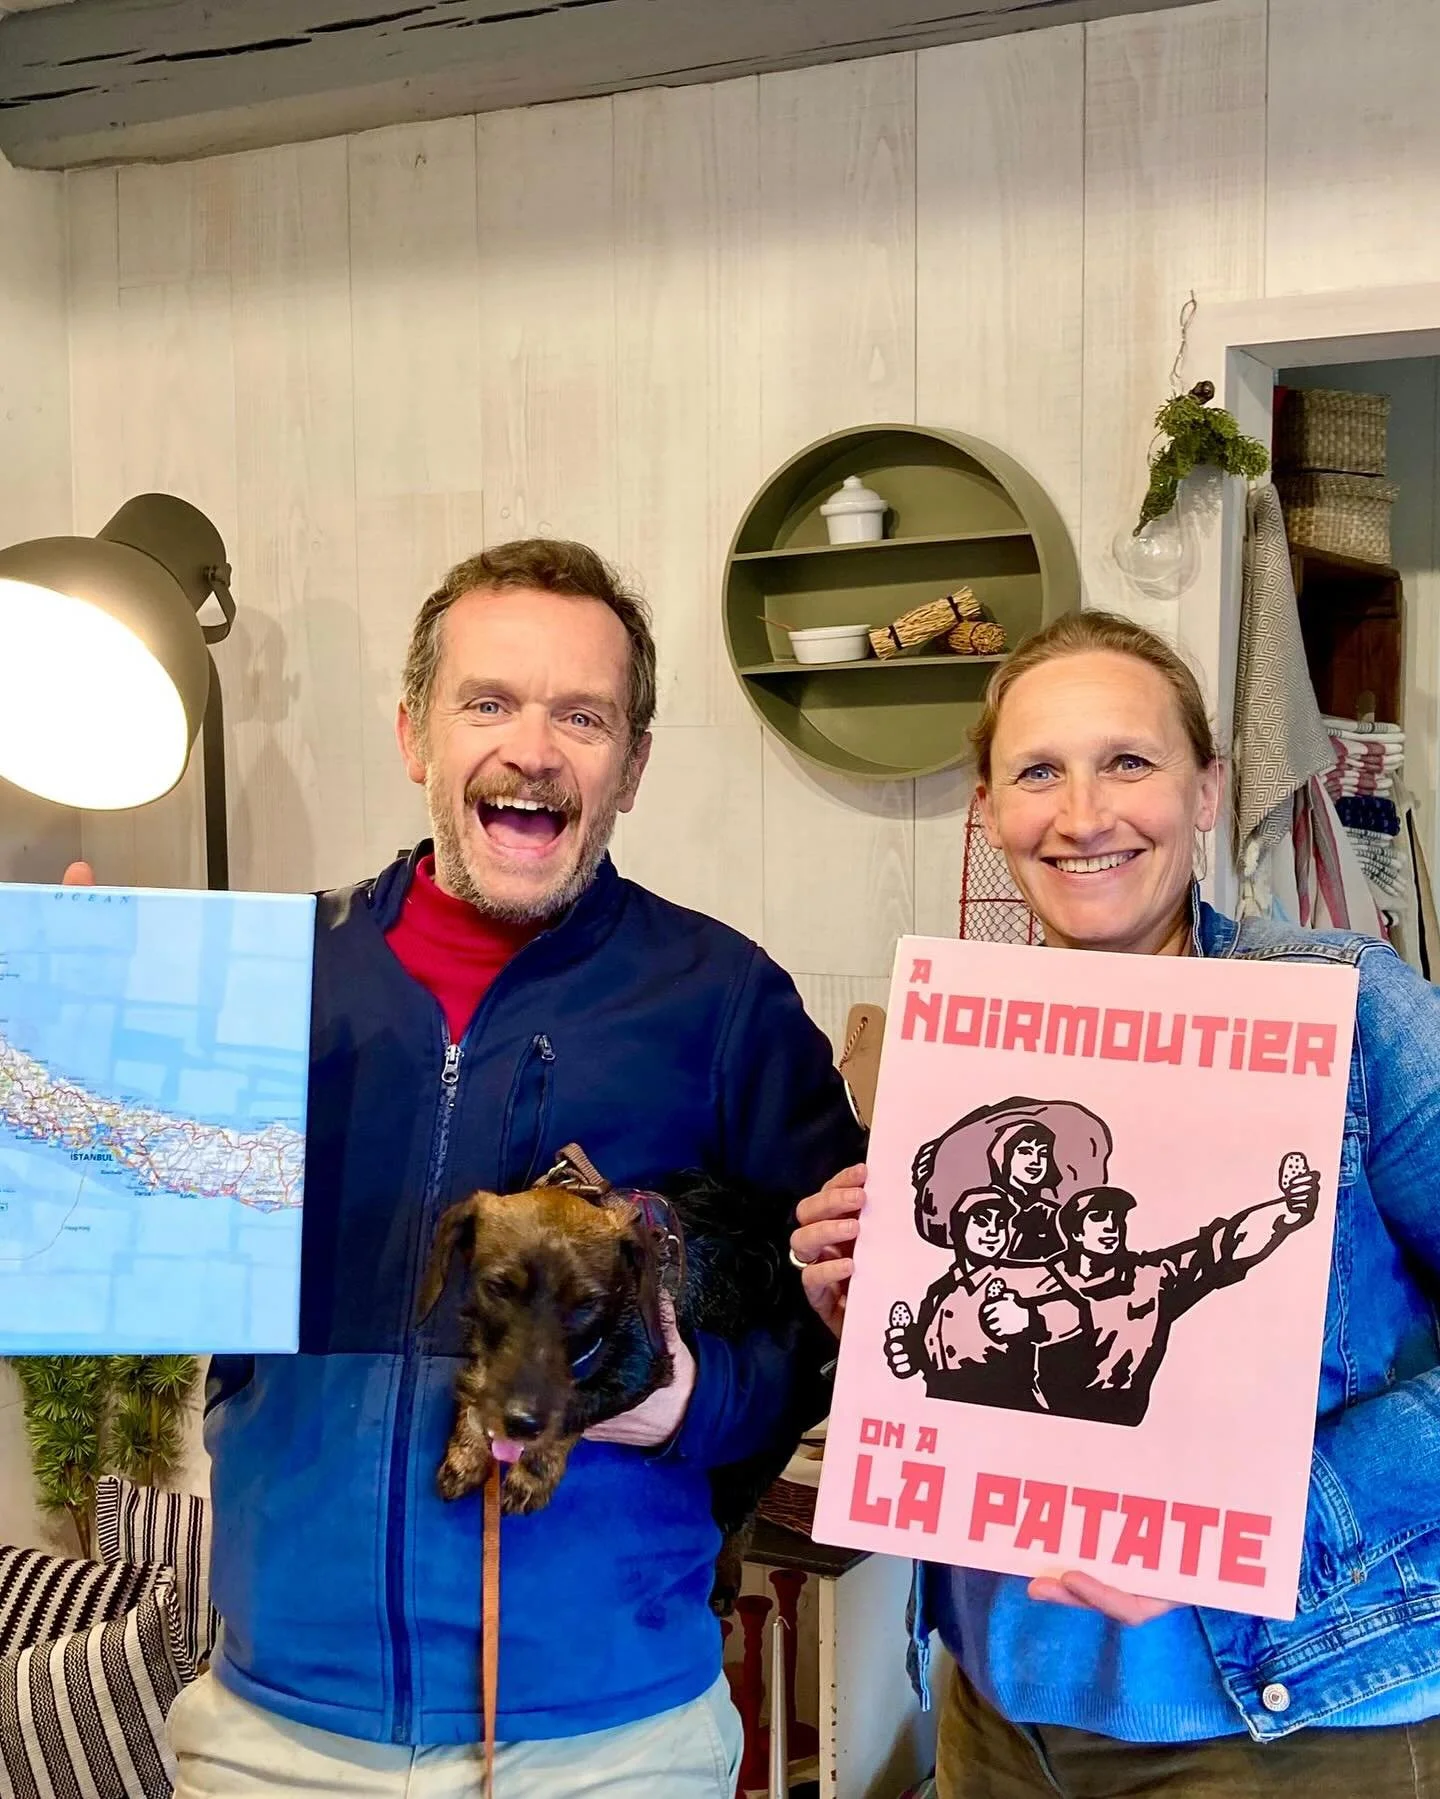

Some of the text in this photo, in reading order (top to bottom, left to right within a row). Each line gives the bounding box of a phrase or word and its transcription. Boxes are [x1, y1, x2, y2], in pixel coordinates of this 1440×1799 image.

[910, 959, 931, 984] A
[859, 1417, 938, 1454] ON A
[849, 1453, 1272, 1588] LA PATATE
